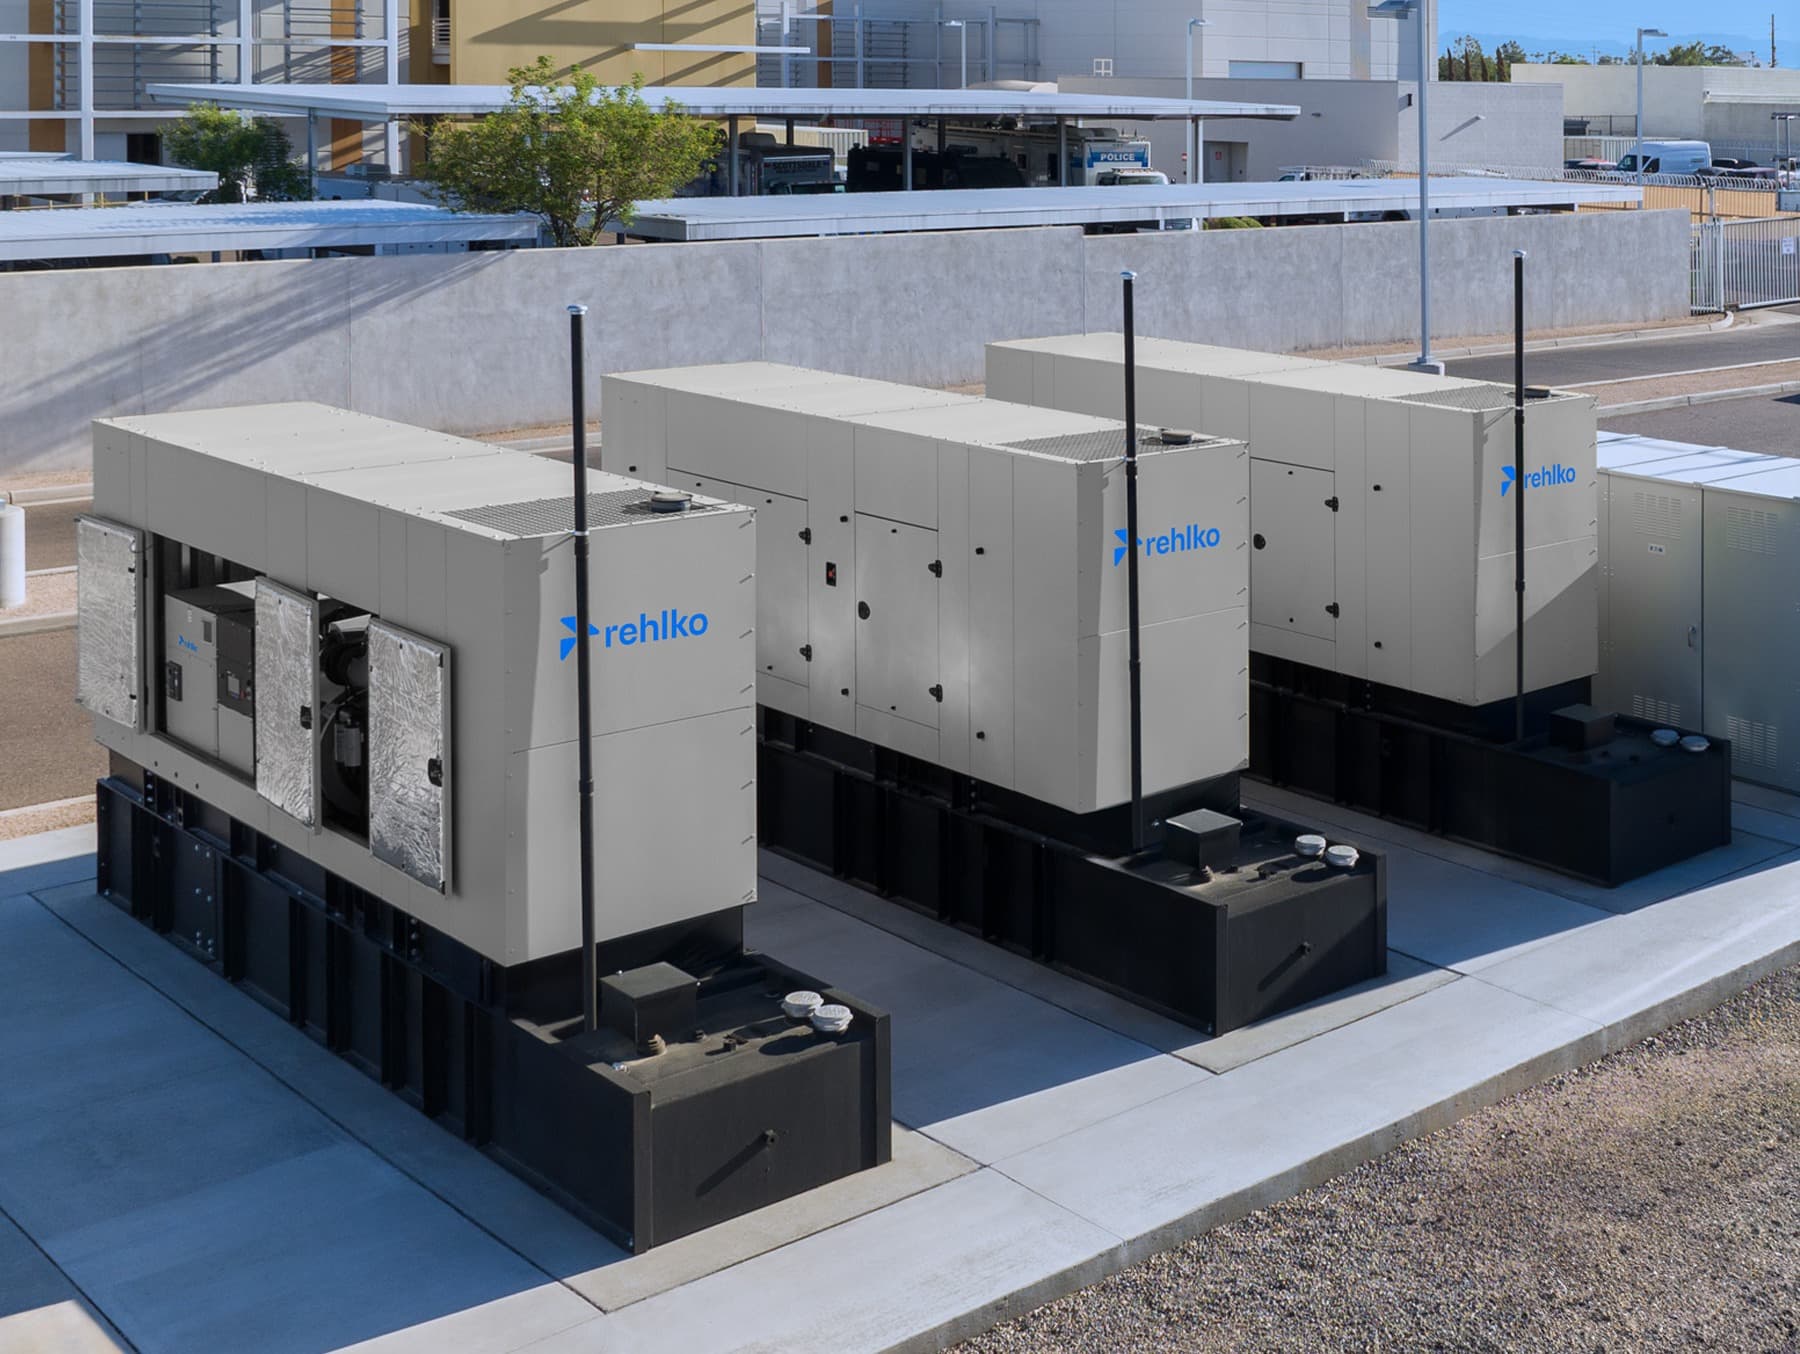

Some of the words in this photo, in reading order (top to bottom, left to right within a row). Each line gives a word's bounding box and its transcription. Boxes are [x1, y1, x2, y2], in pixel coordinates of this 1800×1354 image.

[1100, 153, 1136, 161] POLICE
[1523, 463, 1576, 489] rehlko
[1146, 523, 1220, 557] rehlko
[605, 608, 709, 648] rehlko
